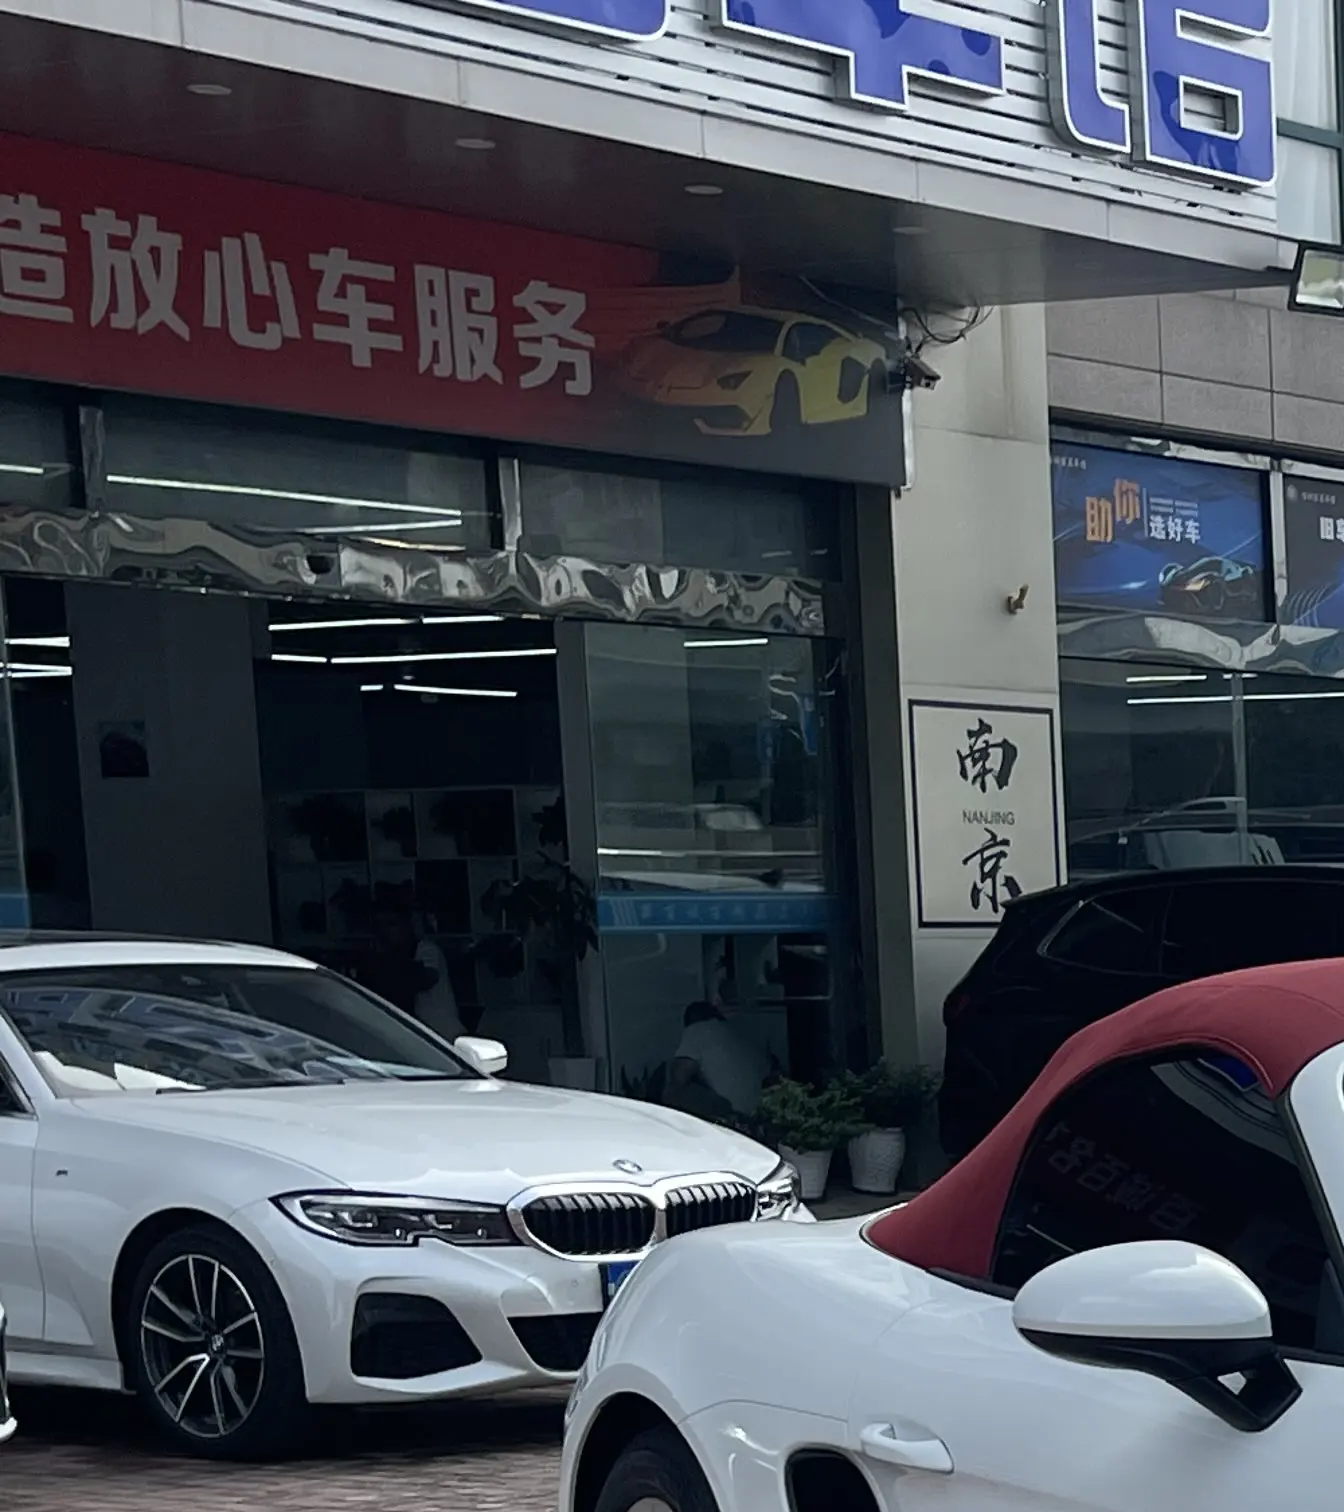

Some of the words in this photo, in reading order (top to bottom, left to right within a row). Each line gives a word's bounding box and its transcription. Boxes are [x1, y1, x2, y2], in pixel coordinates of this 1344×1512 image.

[1085, 478, 1141, 543] 助你
[1149, 515, 1201, 545] 选好车
[957, 717, 1018, 794] 南
[963, 809, 1016, 825] NANJING
[962, 827, 1023, 914] 京
